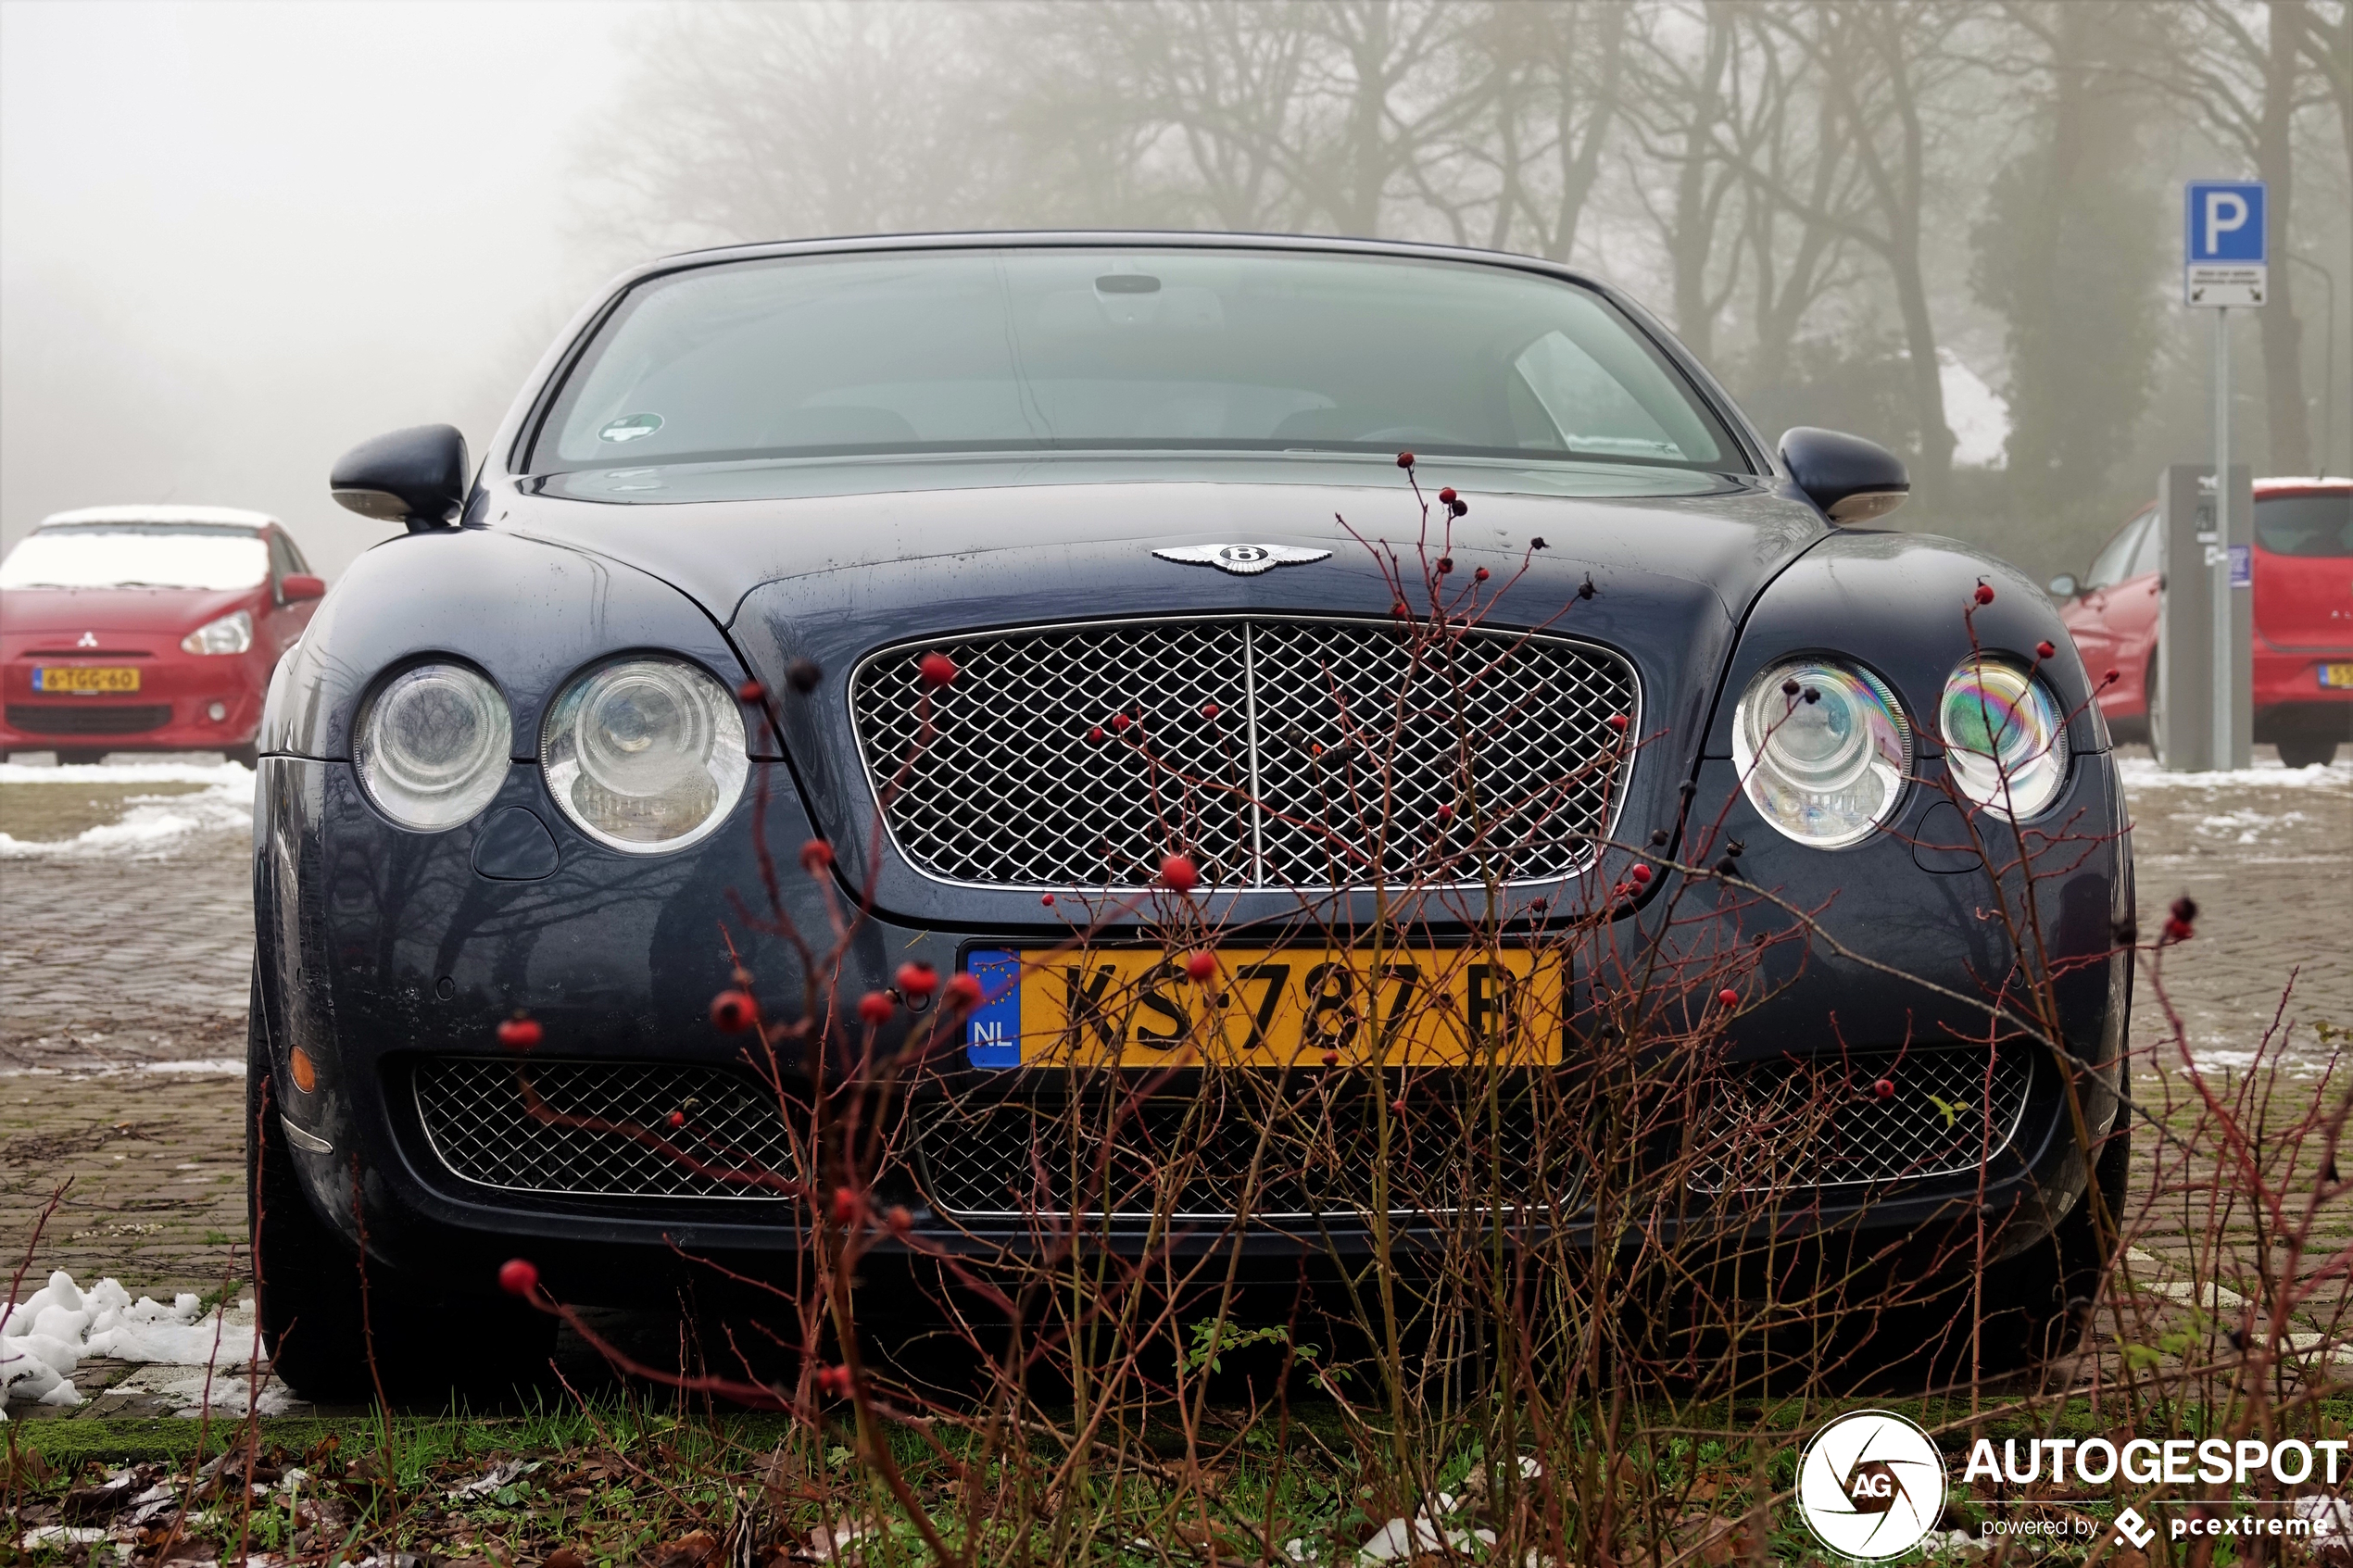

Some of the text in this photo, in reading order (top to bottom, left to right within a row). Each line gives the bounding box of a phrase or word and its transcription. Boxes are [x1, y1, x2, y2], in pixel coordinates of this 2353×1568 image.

[2206, 191, 2249, 255] P
[48, 671, 133, 688] 6-TGG-60
[1065, 961, 1517, 1051] KS-787-B
[974, 1022, 1013, 1047] NL
